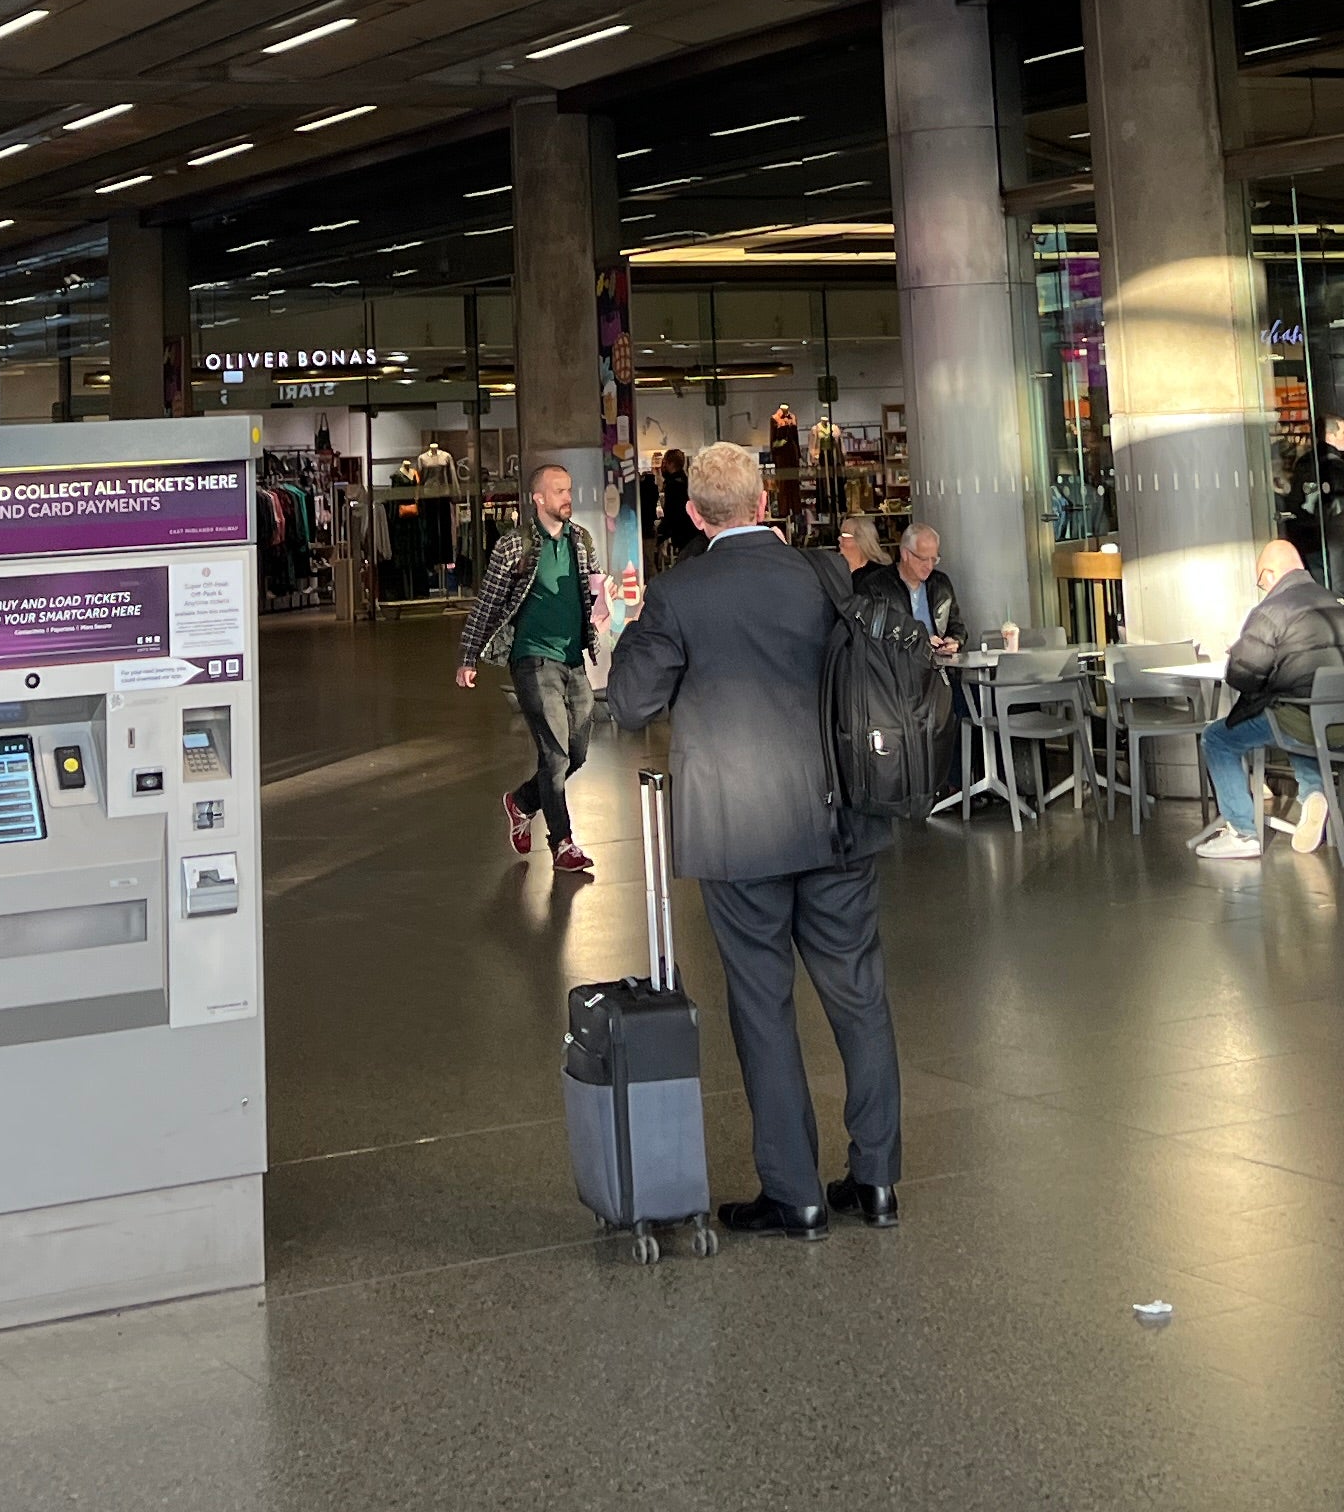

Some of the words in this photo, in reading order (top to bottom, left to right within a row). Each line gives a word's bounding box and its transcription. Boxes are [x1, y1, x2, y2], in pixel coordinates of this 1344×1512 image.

[205, 352, 290, 371] OLIVER
[297, 348, 378, 367] BONAS
[15, 480, 93, 500] COLLECT
[94, 479, 126, 496] ALL
[128, 476, 195, 494] TICKETS
[197, 474, 239, 490] HERE
[27, 501, 74, 518] CARD
[77, 496, 161, 515] PAYMENTS
[20, 597, 47, 610] AND
[49, 595, 82, 608] LOAD
[84, 592, 131, 606] TICKETS
[4, 612, 36, 626] YOUR
[39, 607, 109, 623] SMARTCARD
[111, 605, 142, 618] HERE
